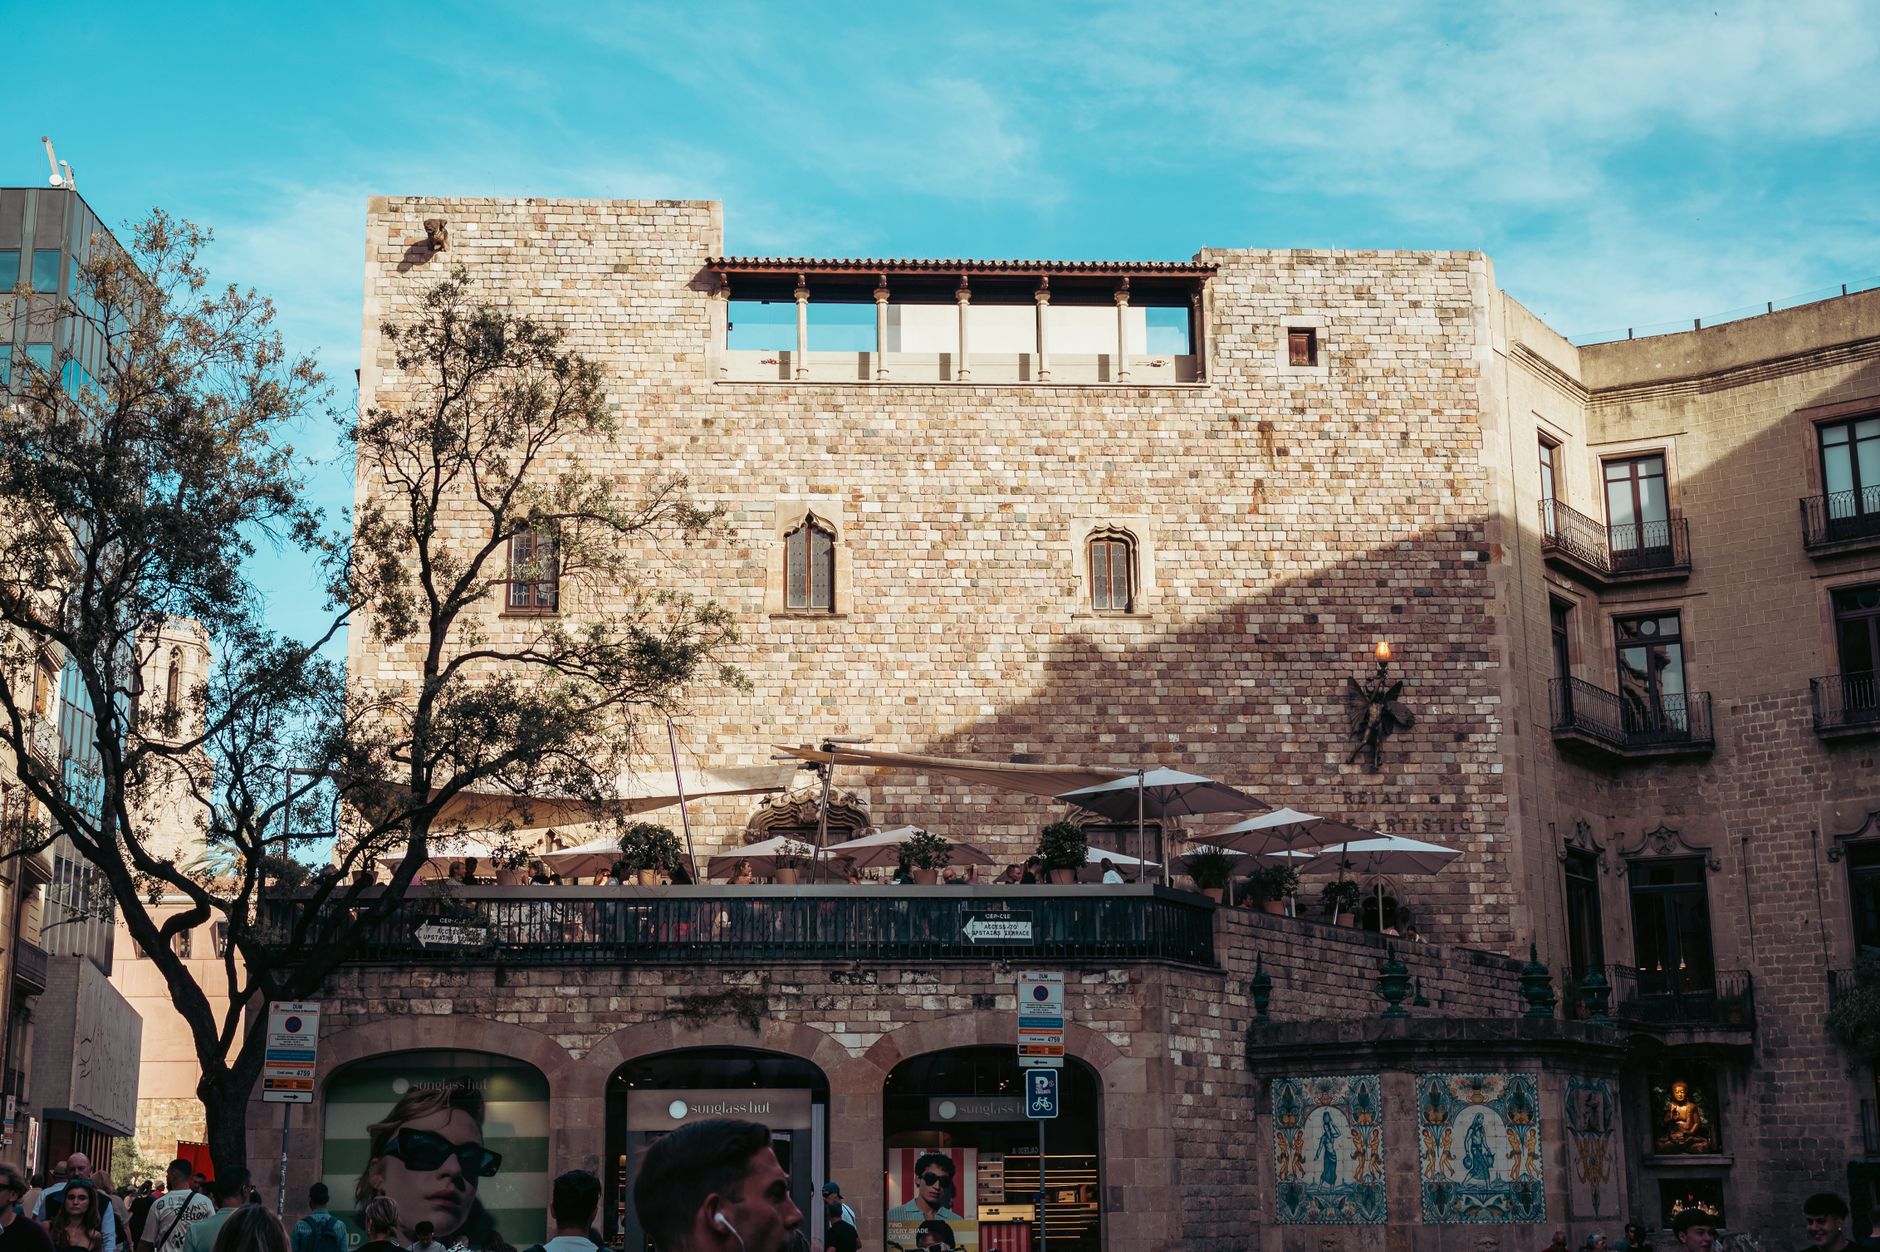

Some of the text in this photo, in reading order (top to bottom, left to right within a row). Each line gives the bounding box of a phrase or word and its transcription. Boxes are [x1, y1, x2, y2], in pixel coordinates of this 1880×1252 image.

[296, 1069, 311, 1077] 4759
[413, 1078, 488, 1092] sunglass hut
[690, 1101, 771, 1116] sunglass hut
[959, 1101, 1015, 1117] sunglass
